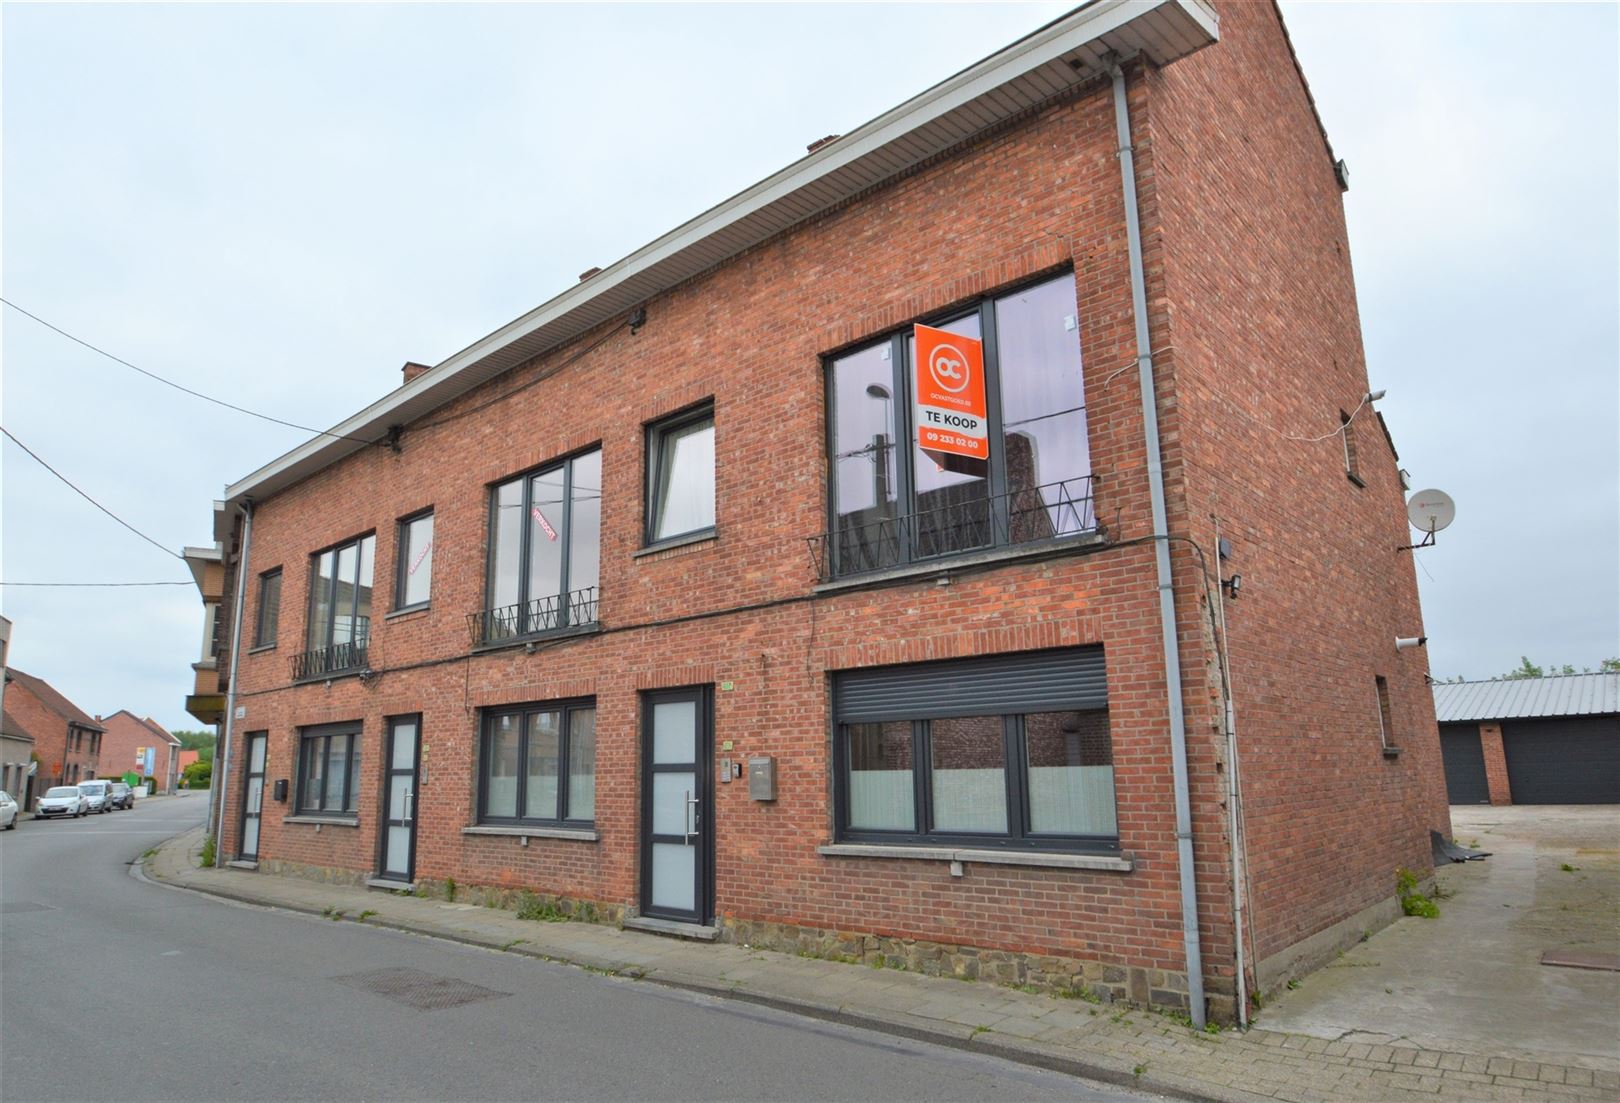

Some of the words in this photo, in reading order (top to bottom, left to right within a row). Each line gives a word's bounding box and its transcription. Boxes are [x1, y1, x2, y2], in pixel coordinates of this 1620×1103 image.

[936, 357, 961, 379] OC
[925, 410, 941, 423] TE
[944, 414, 978, 430] KOOP
[926, 432, 938, 442] 09
[939, 434, 955, 445] 233
[955, 437, 967, 447] 02
[967, 440, 979, 449] 00
[532, 508, 556, 540] VERKOCHT
